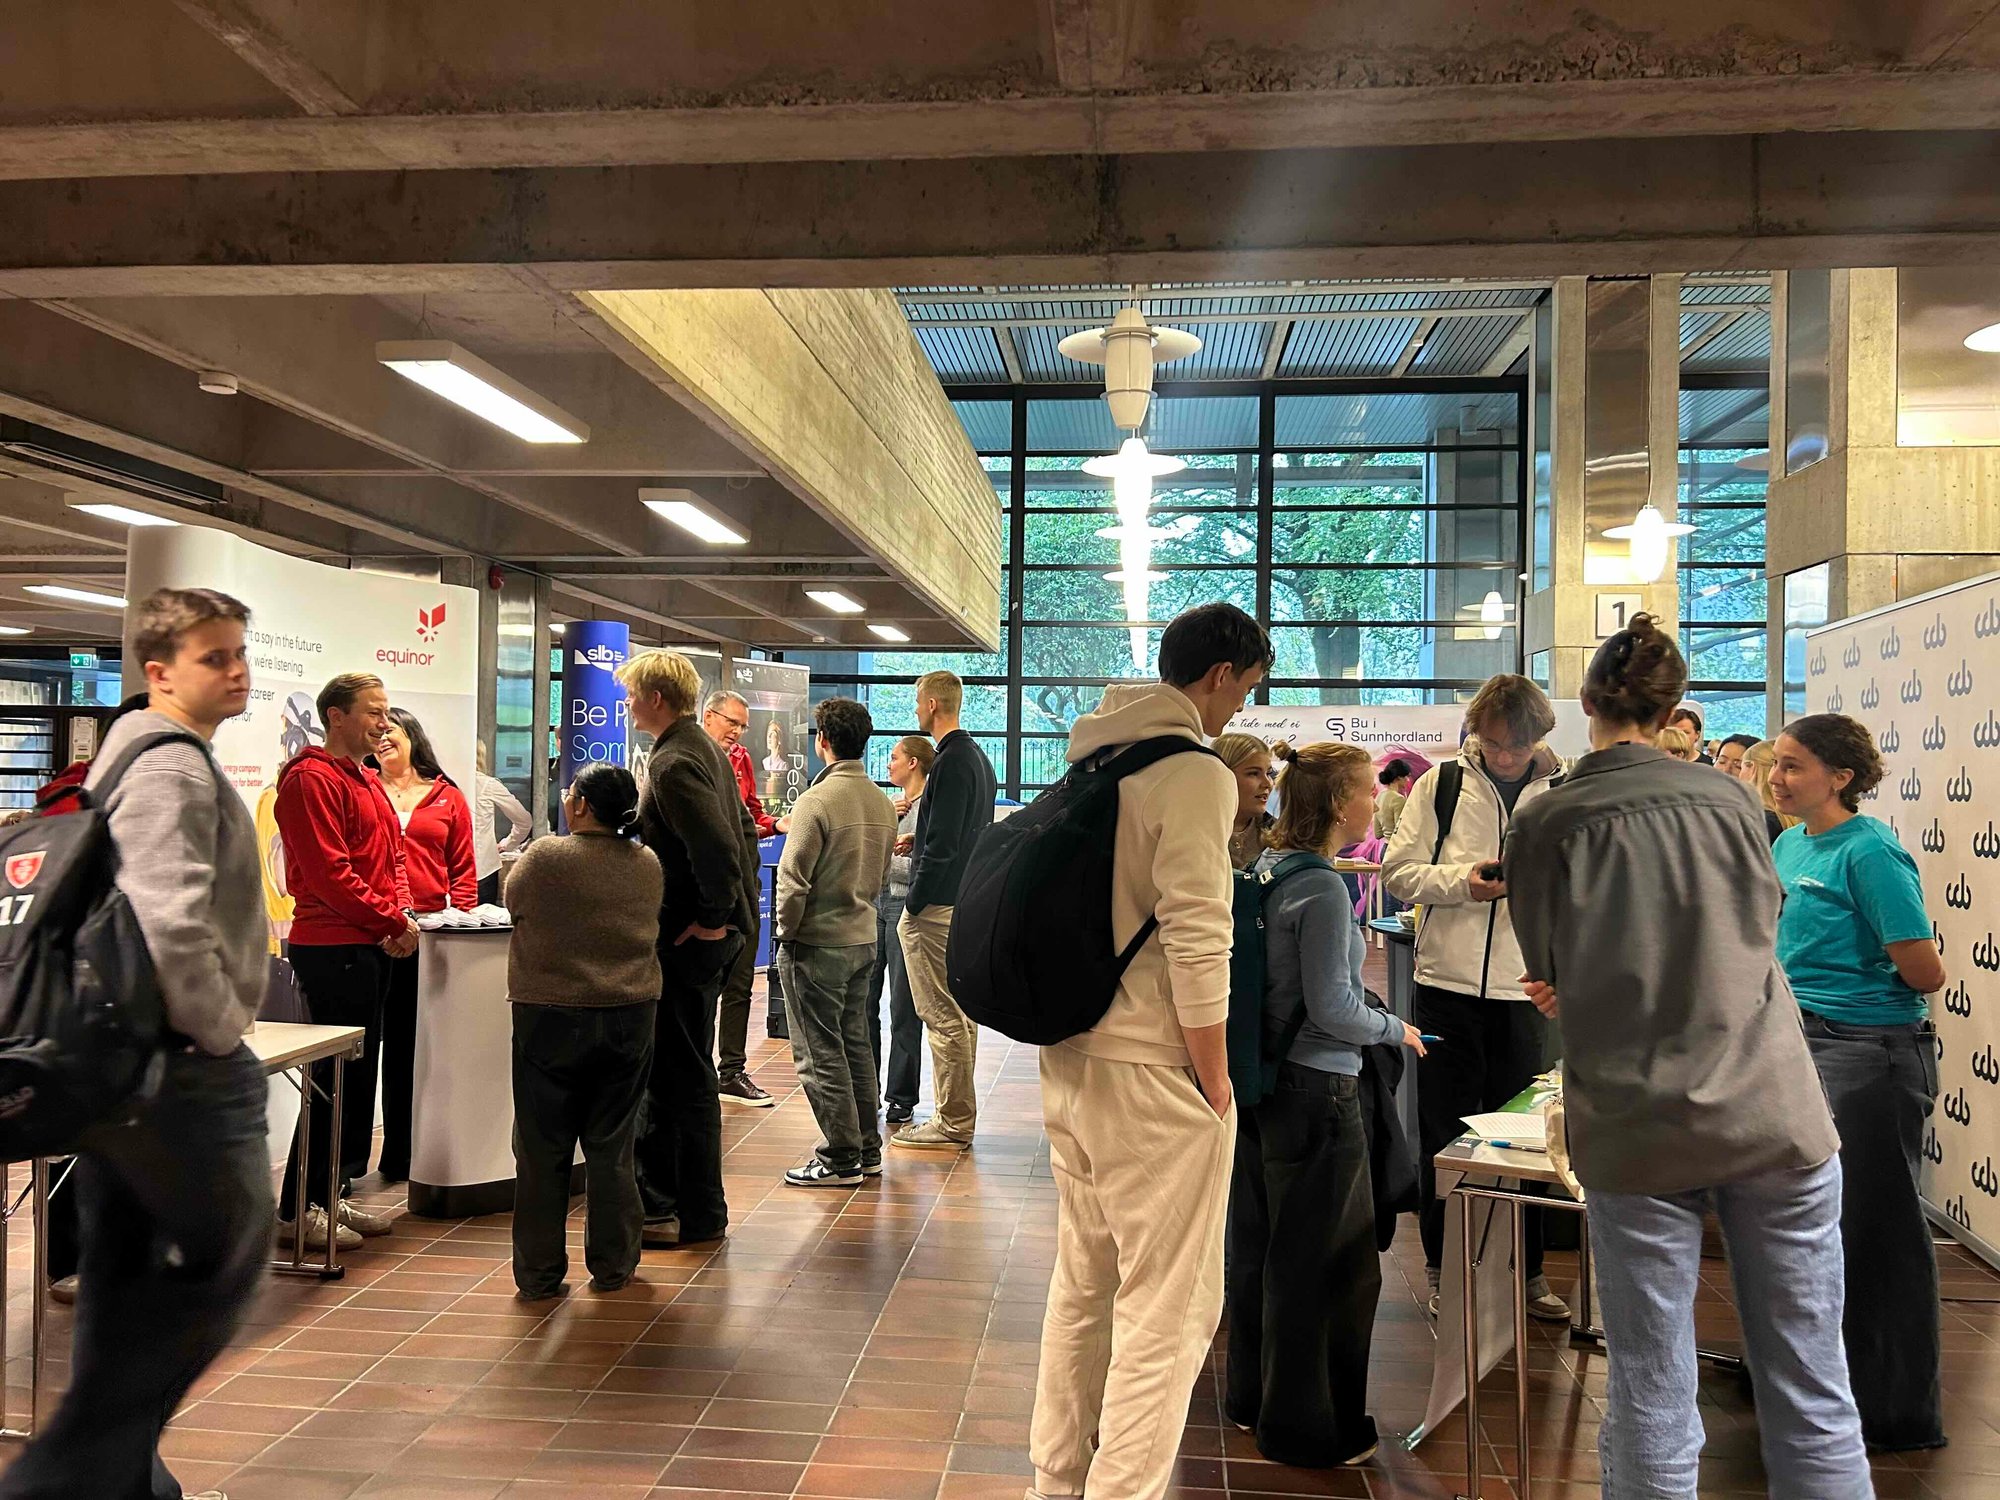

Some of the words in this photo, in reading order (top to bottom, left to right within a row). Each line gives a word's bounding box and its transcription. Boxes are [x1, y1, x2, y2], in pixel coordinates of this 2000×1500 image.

[1612, 601, 1625, 629] 1
[254, 631, 260, 642] a
[261, 632, 274, 648] say
[275, 632, 282, 647] in
[282, 634, 294, 649] the
[295, 635, 322, 653] future
[376, 647, 435, 667] equinor
[587, 644, 614, 661] slb
[254, 653, 273, 670] we're
[250, 688, 275, 701] career
[572, 698, 608, 727] Be
[1240, 718, 1260, 728] tide
[1264, 718, 1288, 729] med
[1290, 720, 1301, 729] ei
[1351, 717, 1368, 728] Bu
[1373, 717, 1377, 728] i
[1350, 730, 1443, 743] Sunnhordland
[0, 893, 35, 926] 17
